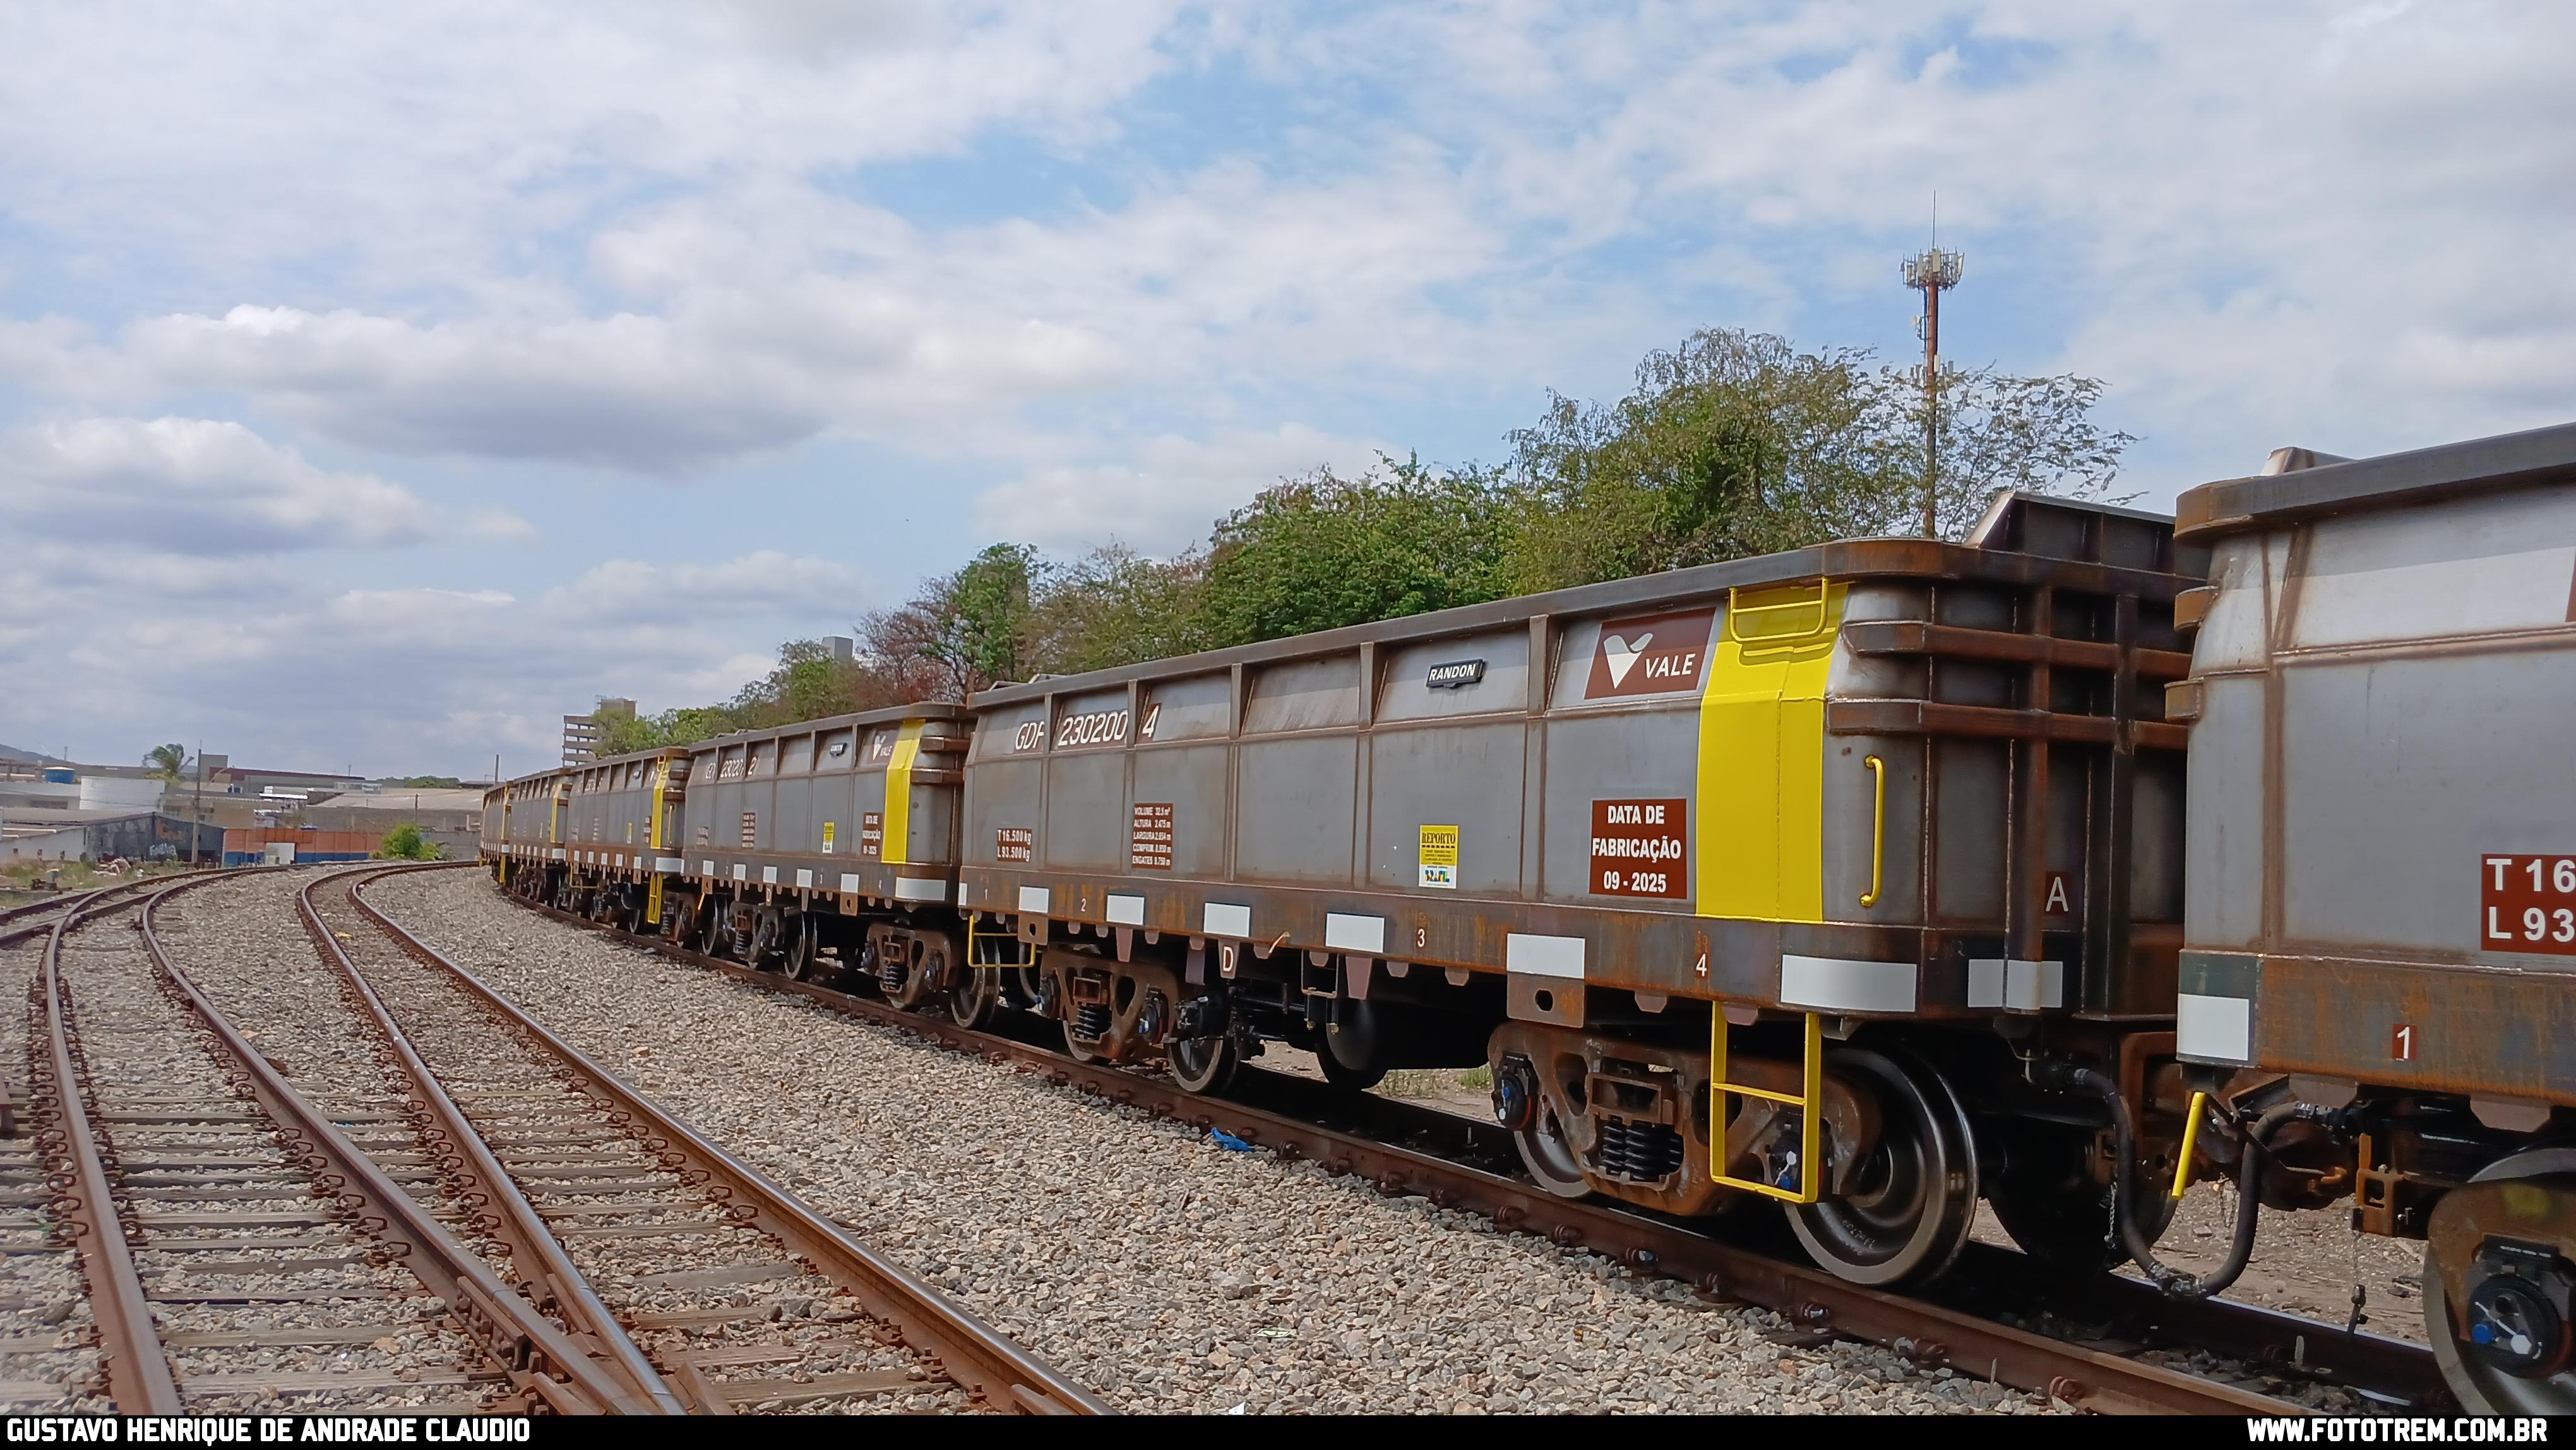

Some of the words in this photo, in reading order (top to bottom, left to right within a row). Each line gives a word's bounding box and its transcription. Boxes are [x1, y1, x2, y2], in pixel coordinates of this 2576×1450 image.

[1429, 664, 1476, 681] RANDON
[1646, 654, 1696, 678] VALE
[1058, 710, 1128, 746] 230200
[1142, 705, 1159, 738] 4
[1134, 819, 1152, 828] ALTURA
[1607, 805, 1642, 824] DATA
[1645, 805, 1664, 824] DE
[998, 829, 1002, 841] T
[1003, 829, 1023, 842] 16.500
[1024, 830, 1032, 845] kg
[1421, 832, 1456, 844] REPORTO
[998, 846, 1001, 858] L
[1001, 846, 1022, 859] 93.500
[1023, 846, 1030, 862] kg
[1592, 835, 1681, 863] FABRICAÇÃO
[1604, 870, 1620, 890] 09
[1631, 872, 1667, 893] 2025
[2486, 858, 2512, 891] T
[2525, 859, 2576, 893] 16
[984, 889, 988, 900] 1
[1080, 898, 1087, 912] 2
[2045, 877, 2069, 912] A
[2489, 906, 2512, 939] L
[2523, 907, 2575, 942] 93
[1417, 928, 1425, 947] 3
[1223, 946, 1234, 972] D
[1696, 953, 1707, 977] 4
[2397, 1026, 2409, 1059] 1
